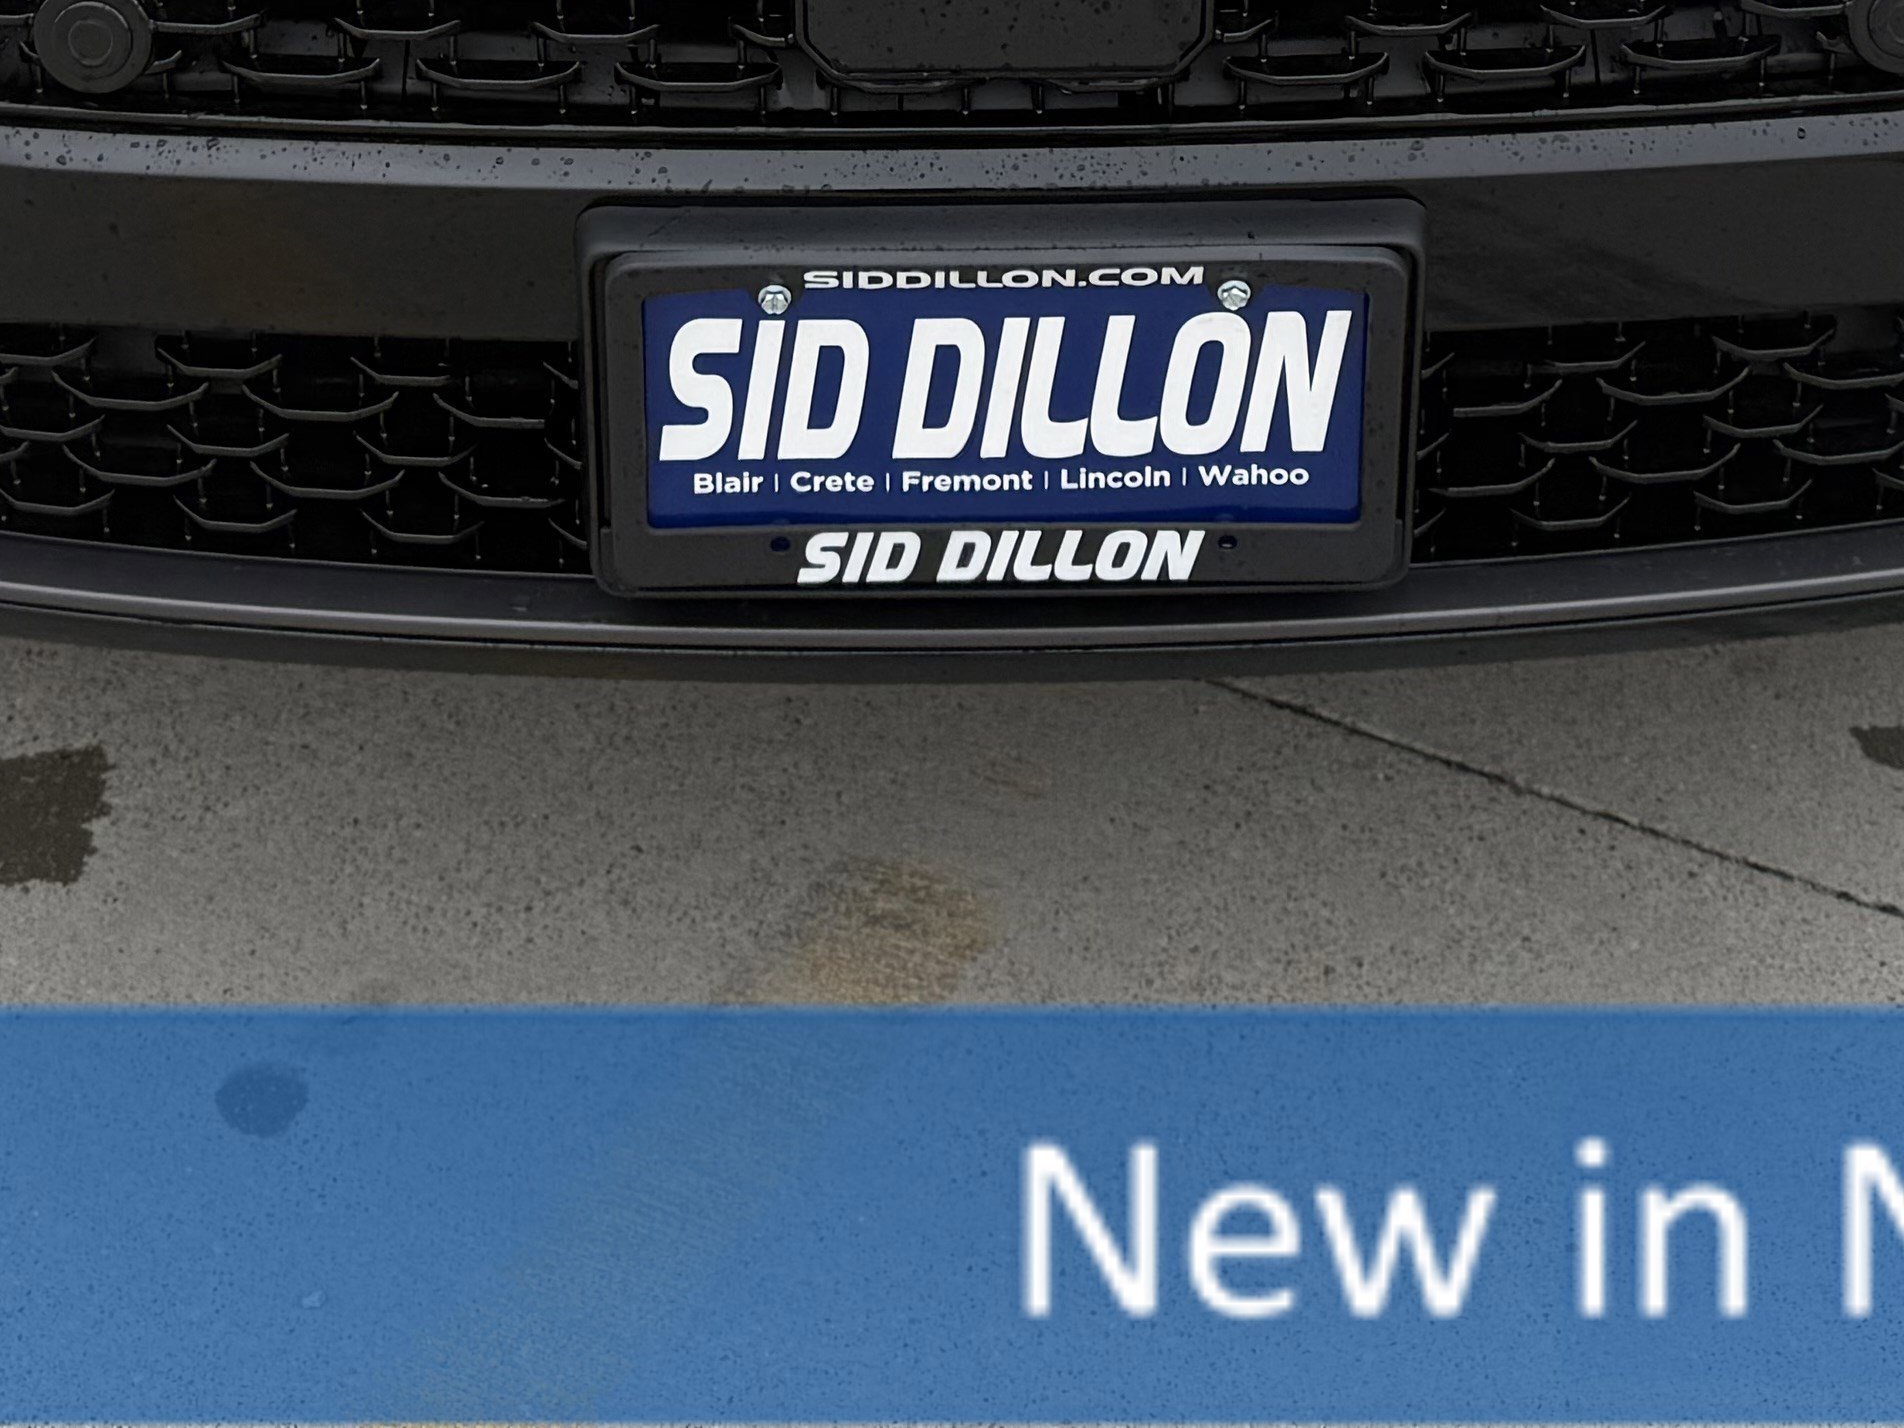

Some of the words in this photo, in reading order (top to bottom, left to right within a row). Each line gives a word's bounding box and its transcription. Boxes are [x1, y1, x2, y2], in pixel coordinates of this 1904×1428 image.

[802, 265, 1205, 290] SIDDILLON.COM
[659, 317, 870, 461] SID
[891, 310, 1353, 460] DILLON
[693, 471, 765, 495] Blair
[790, 470, 875, 493] Crete
[902, 470, 1034, 493] Fremont
[1060, 465, 1172, 490] Lincoln
[1198, 463, 1310, 487] Wahoo
[796, 531, 921, 584] SID
[936, 529, 1206, 582] DILLON
